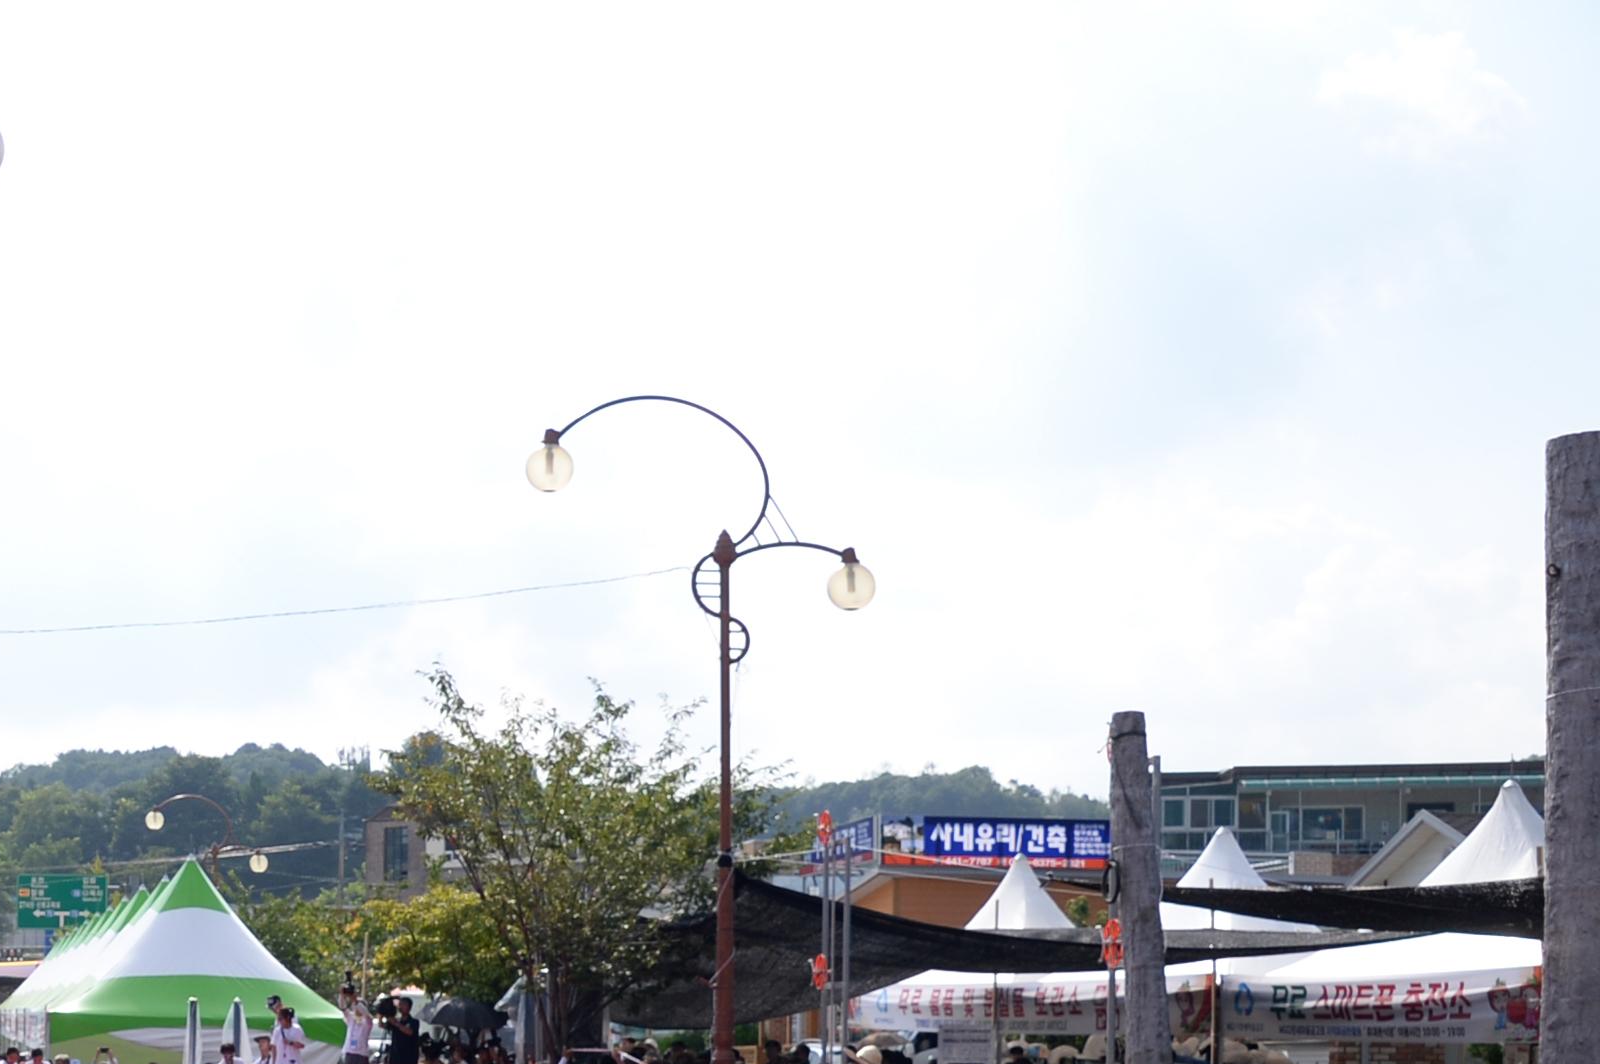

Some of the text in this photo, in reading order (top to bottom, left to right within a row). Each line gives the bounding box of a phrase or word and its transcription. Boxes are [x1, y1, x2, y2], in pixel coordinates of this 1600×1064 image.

[930, 822, 1068, 854] 사내유리/건축
[1267, 982, 1472, 1022] 무료 스마트폰 충전소
